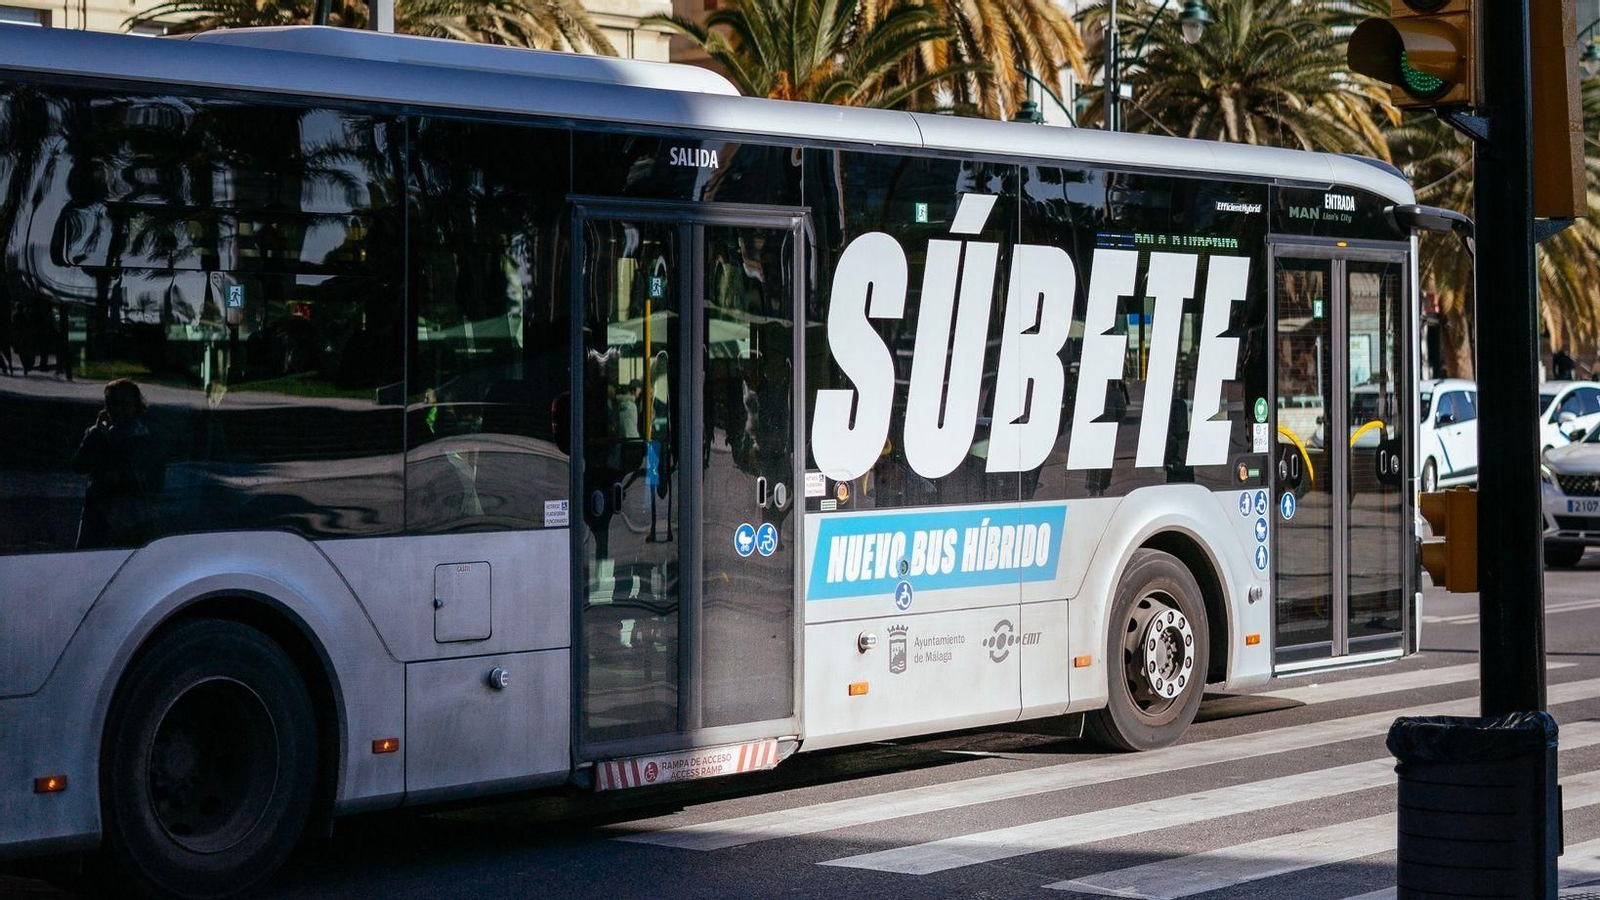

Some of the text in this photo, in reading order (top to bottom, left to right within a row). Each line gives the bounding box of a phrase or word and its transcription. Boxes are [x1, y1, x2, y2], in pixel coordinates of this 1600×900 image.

[670, 146, 719, 169] SALIDA
[1216, 201, 1262, 214] EfficientHybrid
[1324, 193, 1356, 212] ENTRADA
[1289, 206, 1320, 220] MAN
[1322, 212, 1353, 223] Lion's City
[811, 193, 1251, 481] SÚBETE
[1575, 500, 1599, 512] 2107
[826, 517, 1051, 584] NUEVO BUS HÍBRIDO
[914, 634, 966, 648] Ayuntamiento
[1022, 632, 1043, 646] EMT
[914, 651, 953, 664] de Málaga
[661, 753, 732, 770] RAMPA DE ACCESO
[670, 765, 723, 780] ACCESS RAMP
